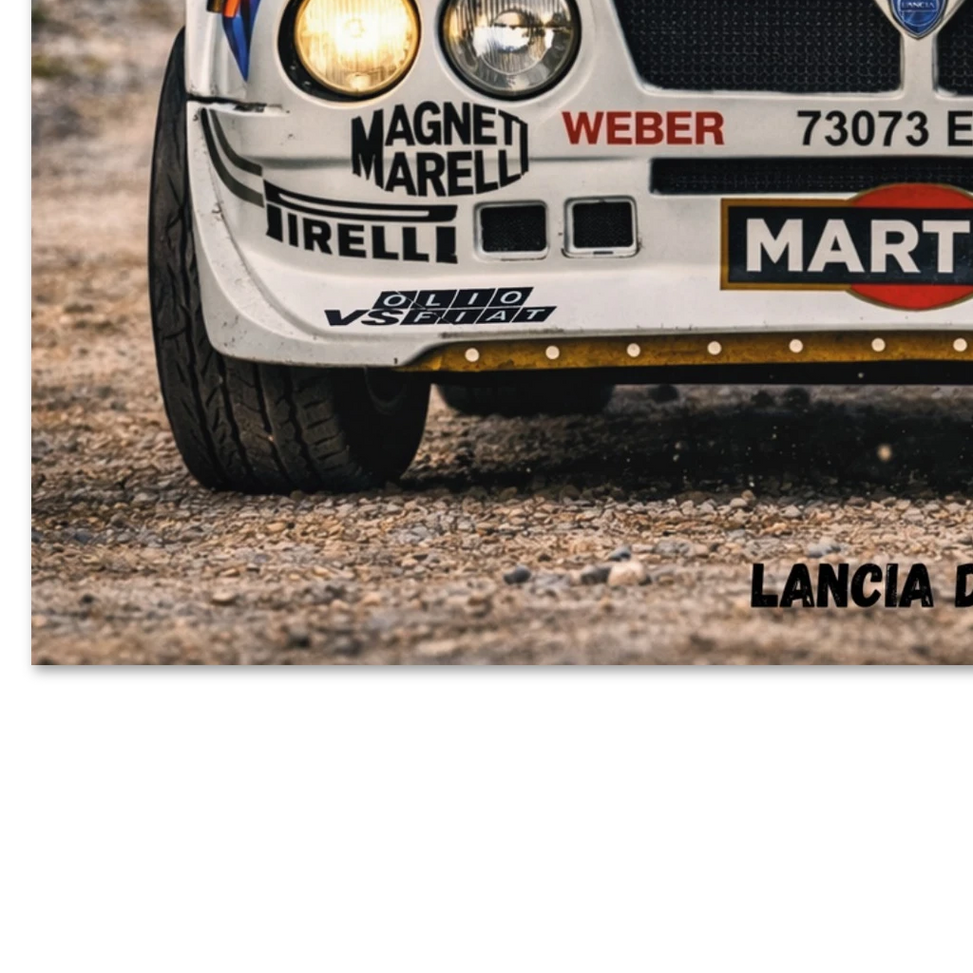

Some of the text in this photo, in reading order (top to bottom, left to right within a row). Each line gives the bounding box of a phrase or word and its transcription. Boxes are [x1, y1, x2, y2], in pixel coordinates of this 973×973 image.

[562, 111, 725, 146] WEBER
[797, 110, 930, 147] 73073
[947, 110, 973, 146] E
[381, 289, 525, 308] OLIO
